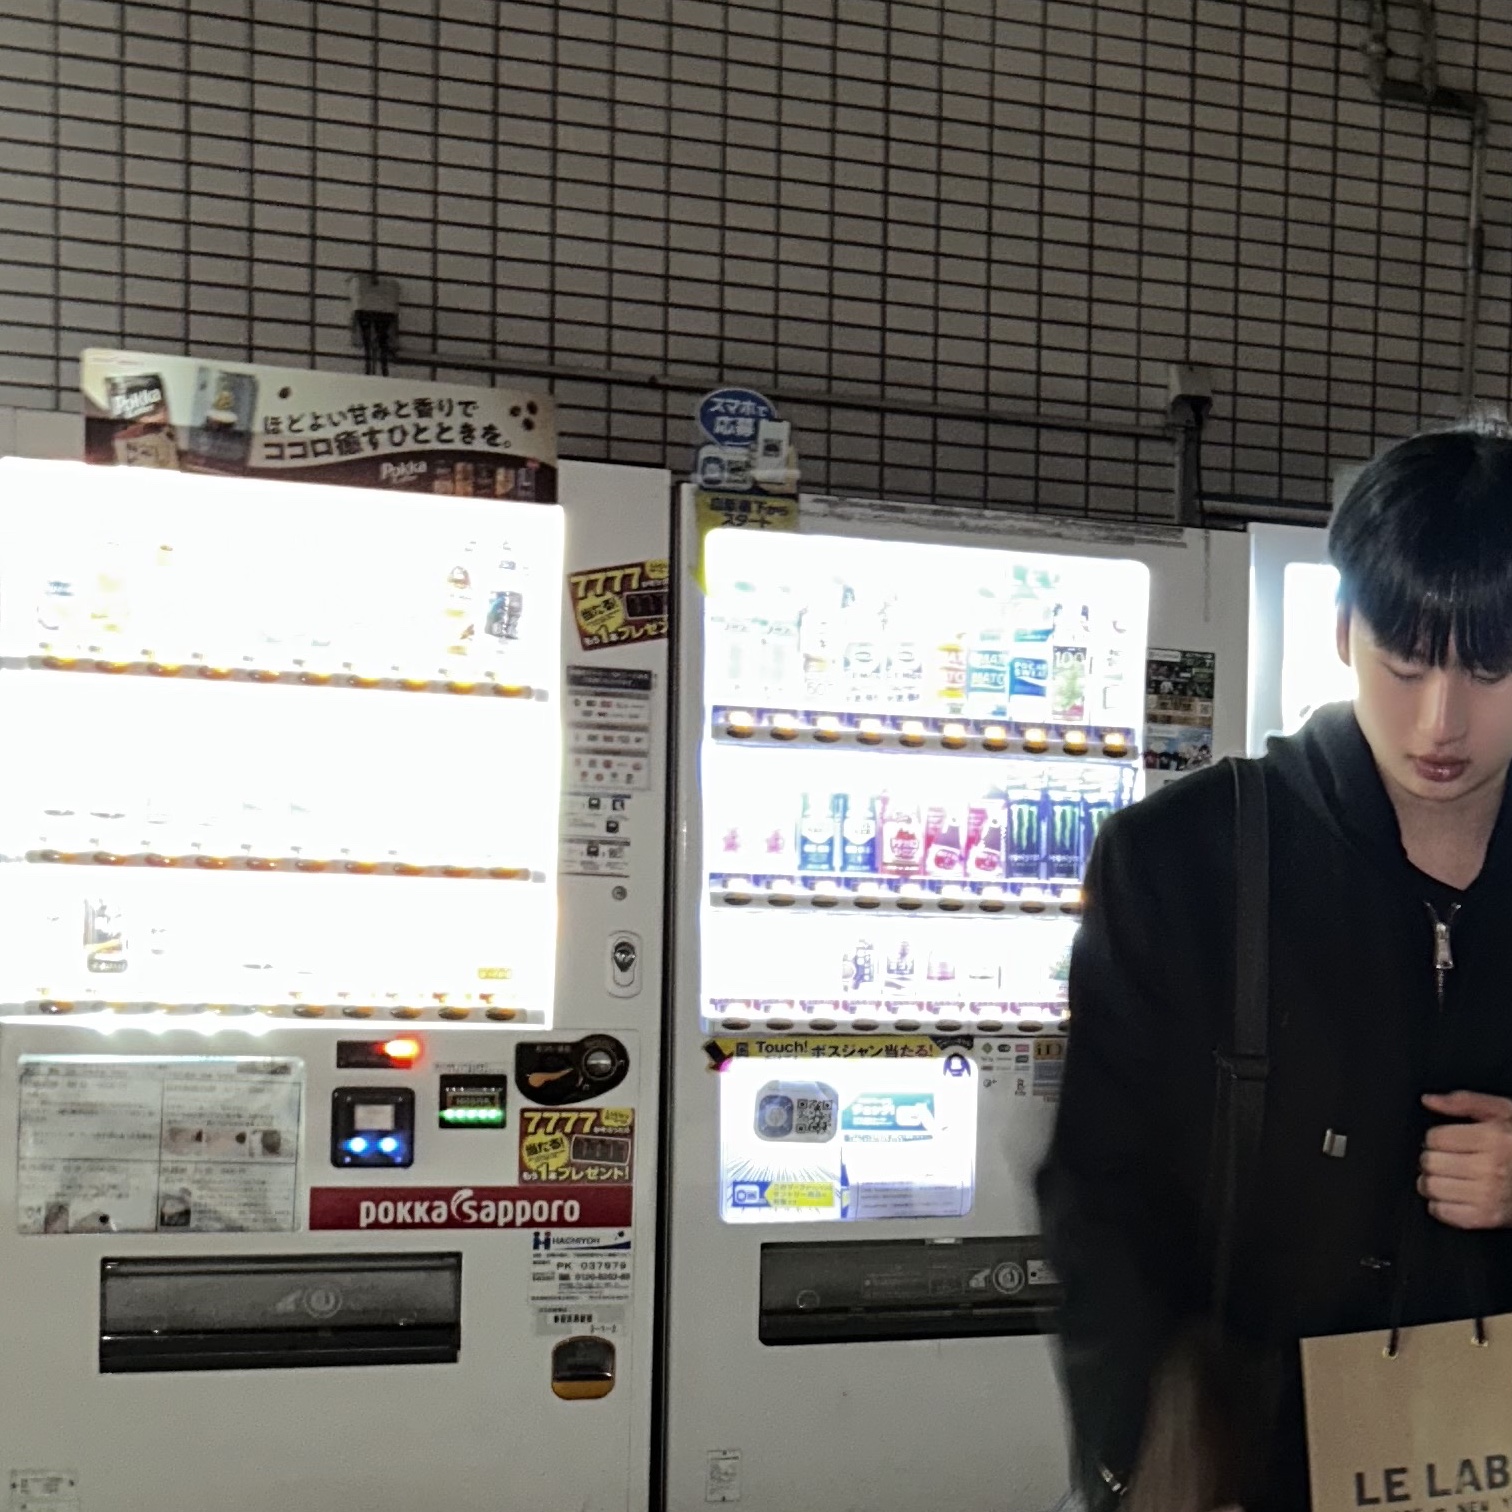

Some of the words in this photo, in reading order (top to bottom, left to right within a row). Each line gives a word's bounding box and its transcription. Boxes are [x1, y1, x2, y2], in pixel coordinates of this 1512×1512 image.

[263, 397, 478, 435] ほどよい甘みと香りで
[263, 422, 511, 460] ココロ癒すひとときを。
[570, 566, 641, 598] 7777
[755, 1040, 808, 1054] Touch!
[811, 1043, 934, 1059] ボスジャン当たる!
[524, 1112, 597, 1133] 7777
[1354, 1466, 1412, 1507] LE
